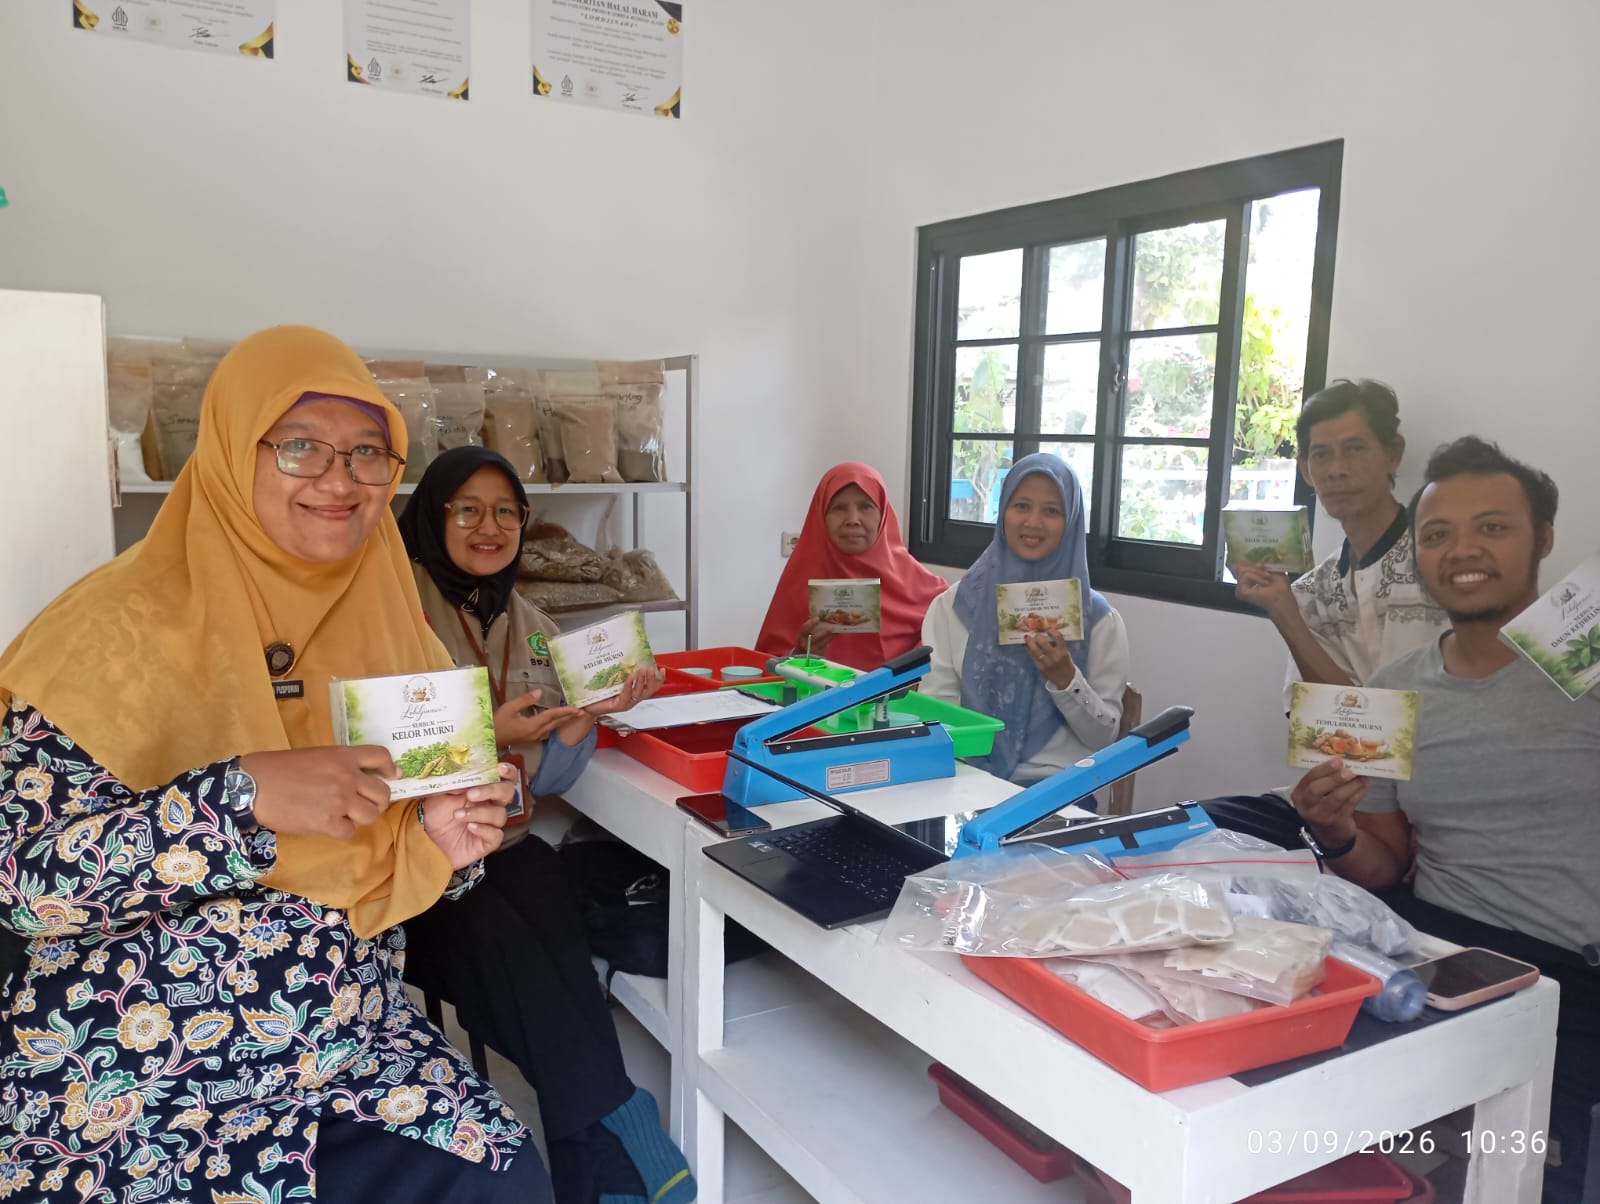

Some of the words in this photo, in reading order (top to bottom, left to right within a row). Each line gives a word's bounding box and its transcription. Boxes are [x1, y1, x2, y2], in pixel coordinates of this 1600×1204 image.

[607, 2, 630, 14] HALAL
[632, 7, 658, 19] HARAM
[1551, 632, 1573, 648] DAUN
[392, 729, 421, 741] KELOR
[423, 725, 454, 737] MURNI
